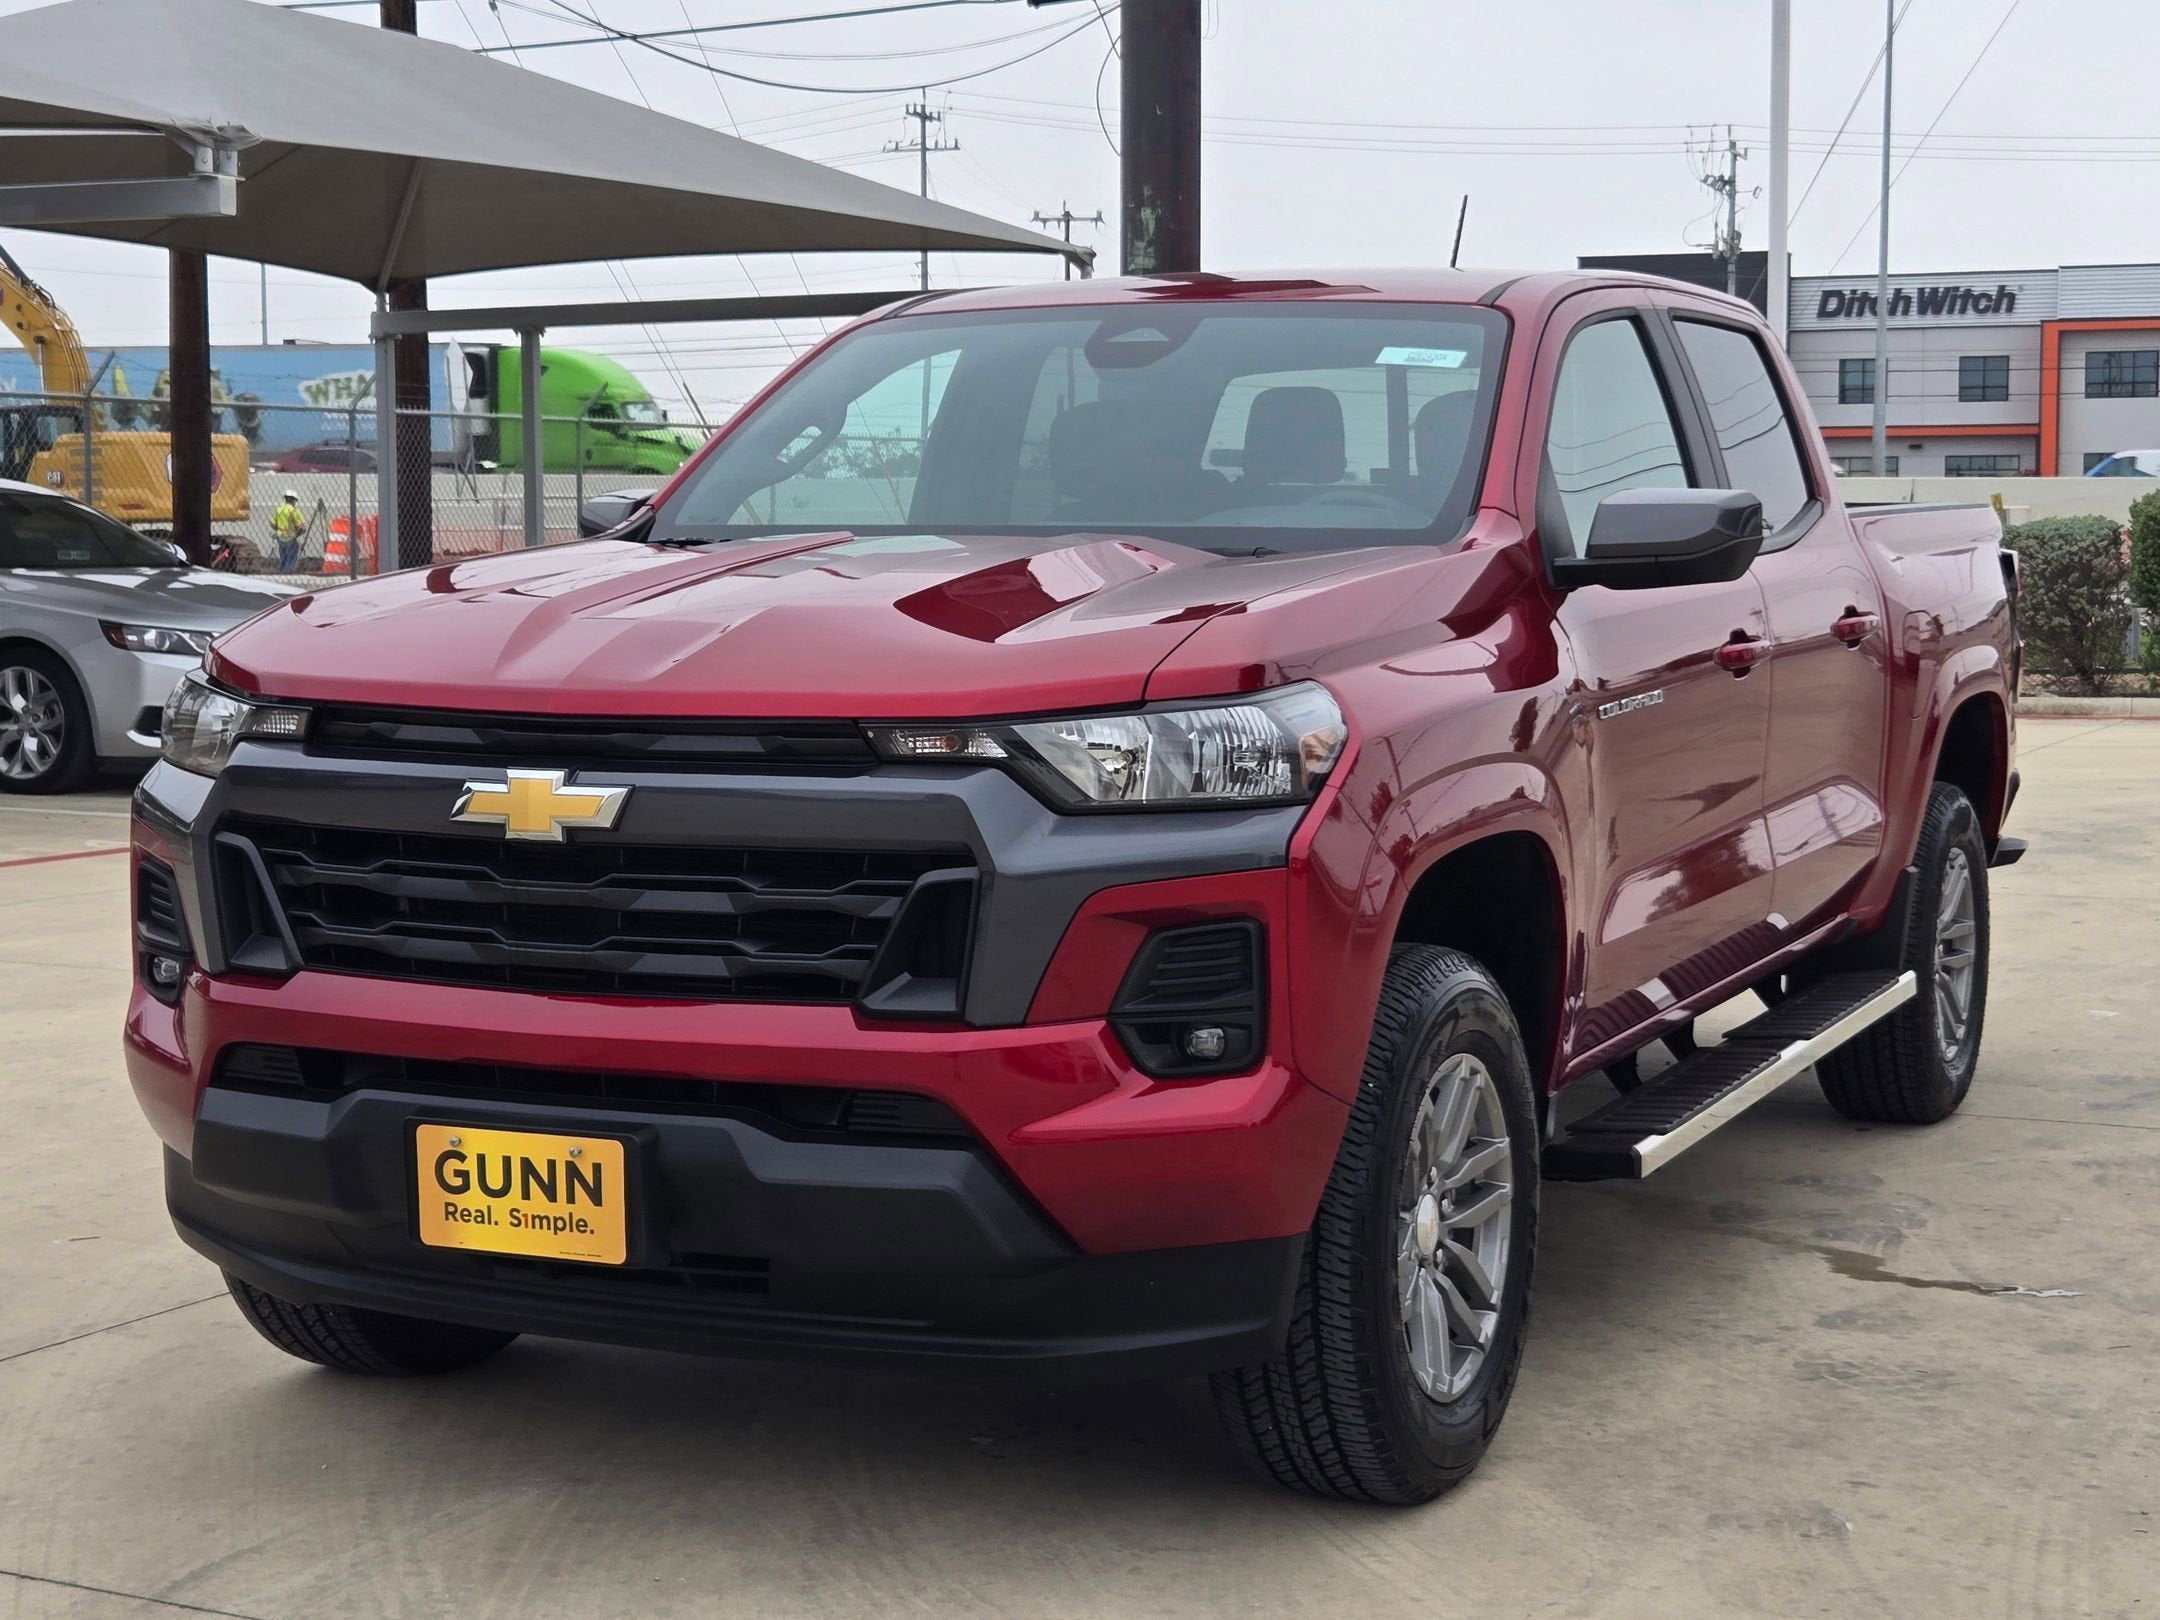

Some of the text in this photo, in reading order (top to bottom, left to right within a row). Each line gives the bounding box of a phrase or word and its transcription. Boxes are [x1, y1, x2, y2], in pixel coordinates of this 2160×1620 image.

[1816, 284, 2017, 318] Ditch Witch
[434, 1149, 604, 1207] GUNN
[444, 1201, 499, 1226] Real.
